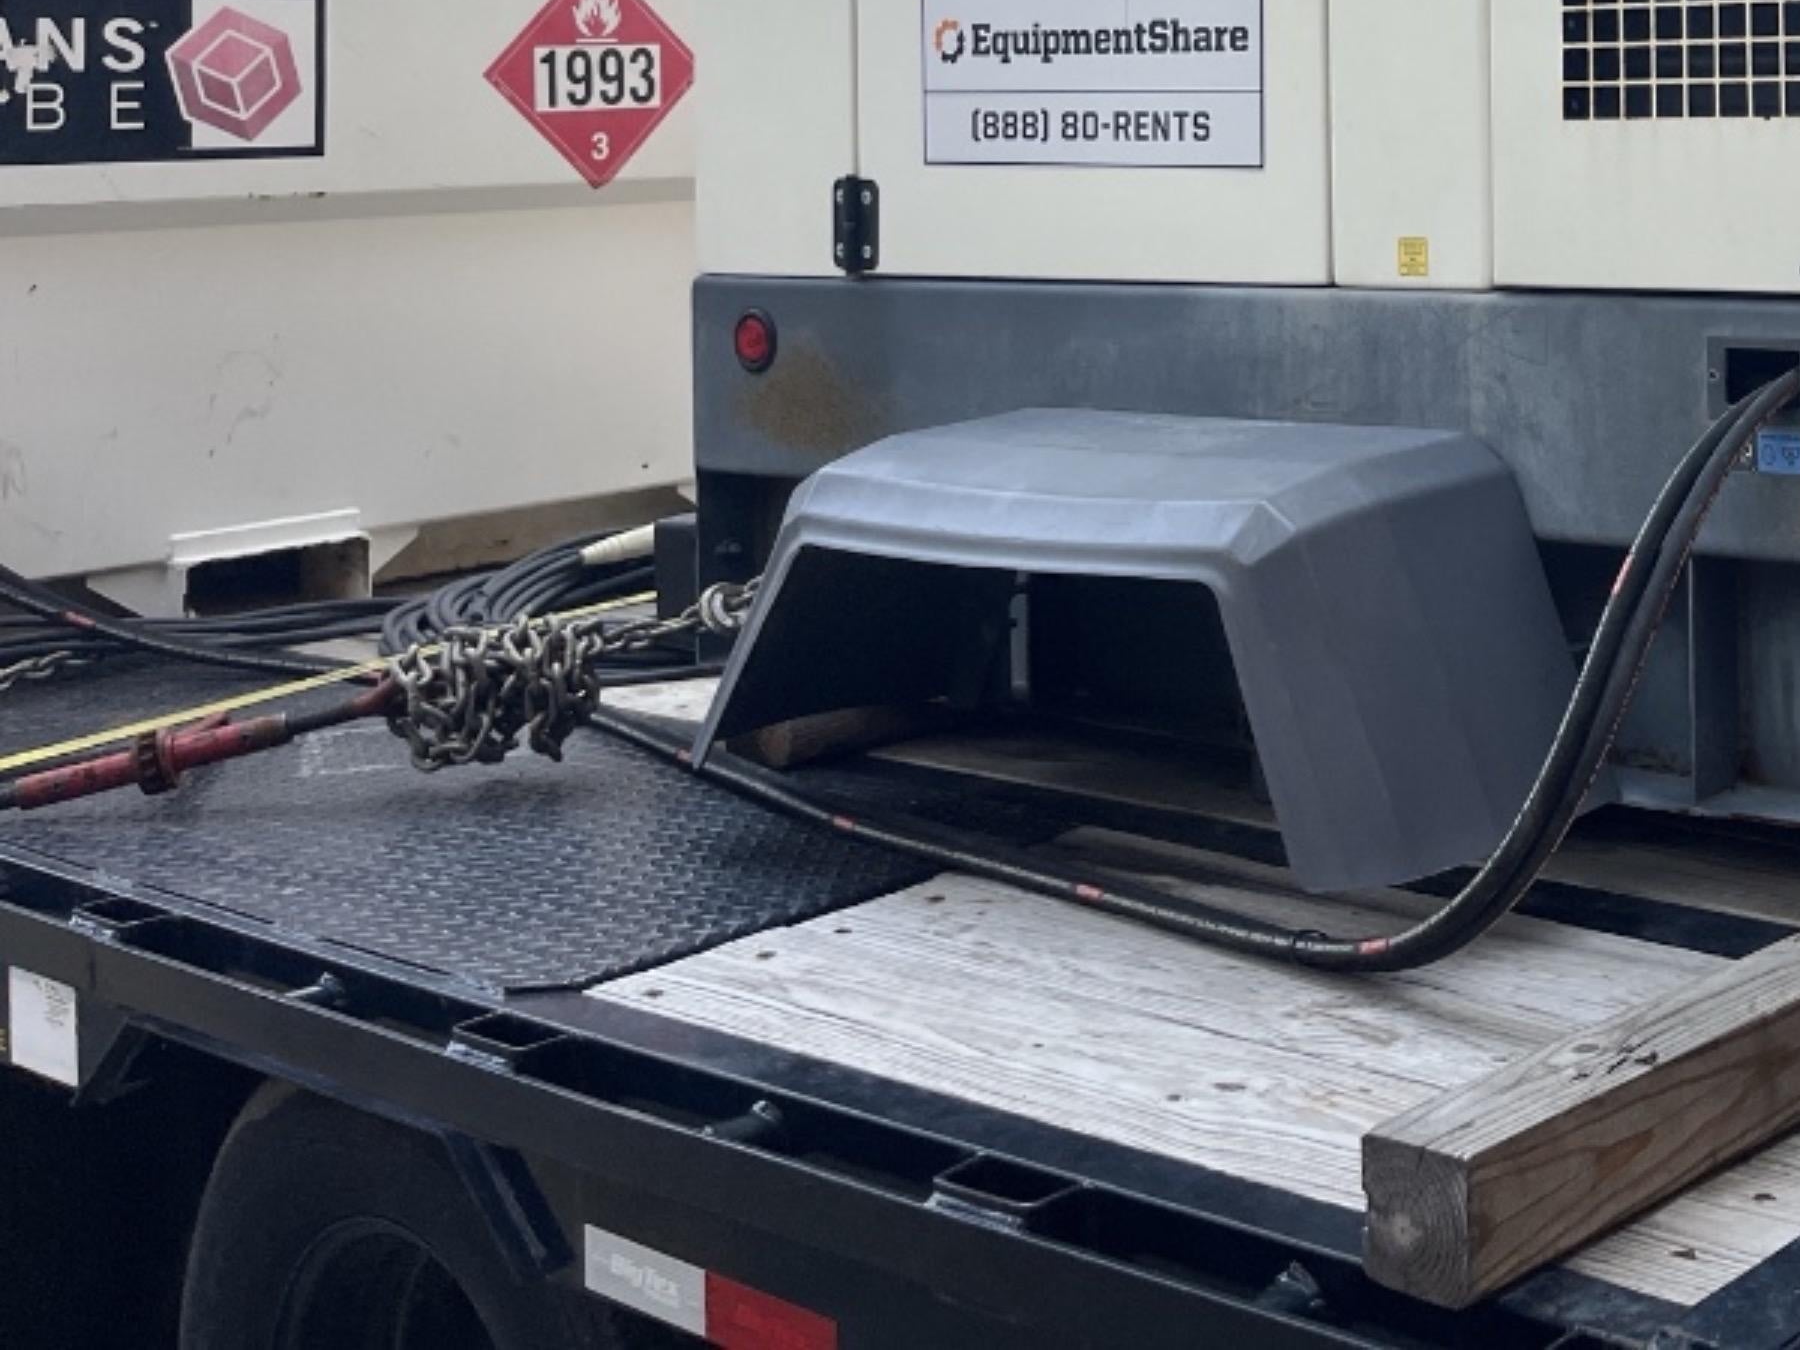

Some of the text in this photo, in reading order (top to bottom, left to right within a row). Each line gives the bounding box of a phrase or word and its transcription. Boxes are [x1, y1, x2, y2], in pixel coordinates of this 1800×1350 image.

[971, 18, 1249, 64] EquipmentShare
[539, 47, 655, 108] 1993
[971, 108, 1211, 143] (888) 80-RENTS
[591, 132, 610, 160] 3
